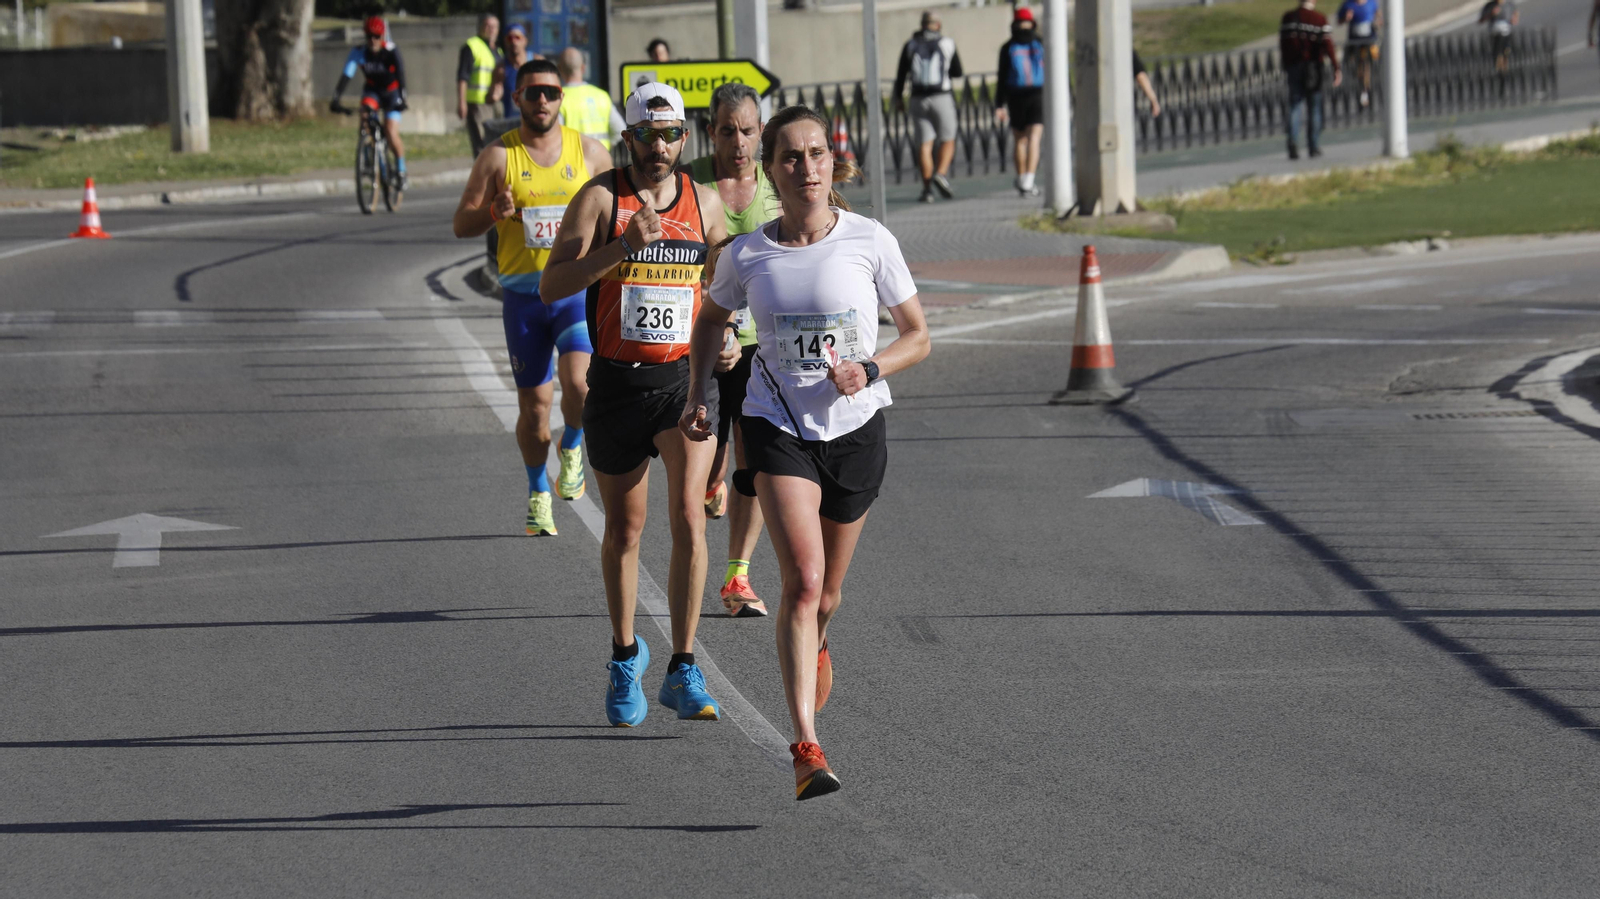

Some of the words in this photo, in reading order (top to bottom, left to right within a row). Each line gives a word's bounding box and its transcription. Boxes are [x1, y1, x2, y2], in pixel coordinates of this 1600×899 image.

[624, 242, 698, 264] letismo
[618, 266, 638, 278] LOS
[636, 306, 674, 329] 236
[640, 332, 676, 341] EVOS
[794, 333, 836, 358] 142
[801, 362, 828, 371] EVO
[760, 371, 776, 396] IMPOSSIBL
